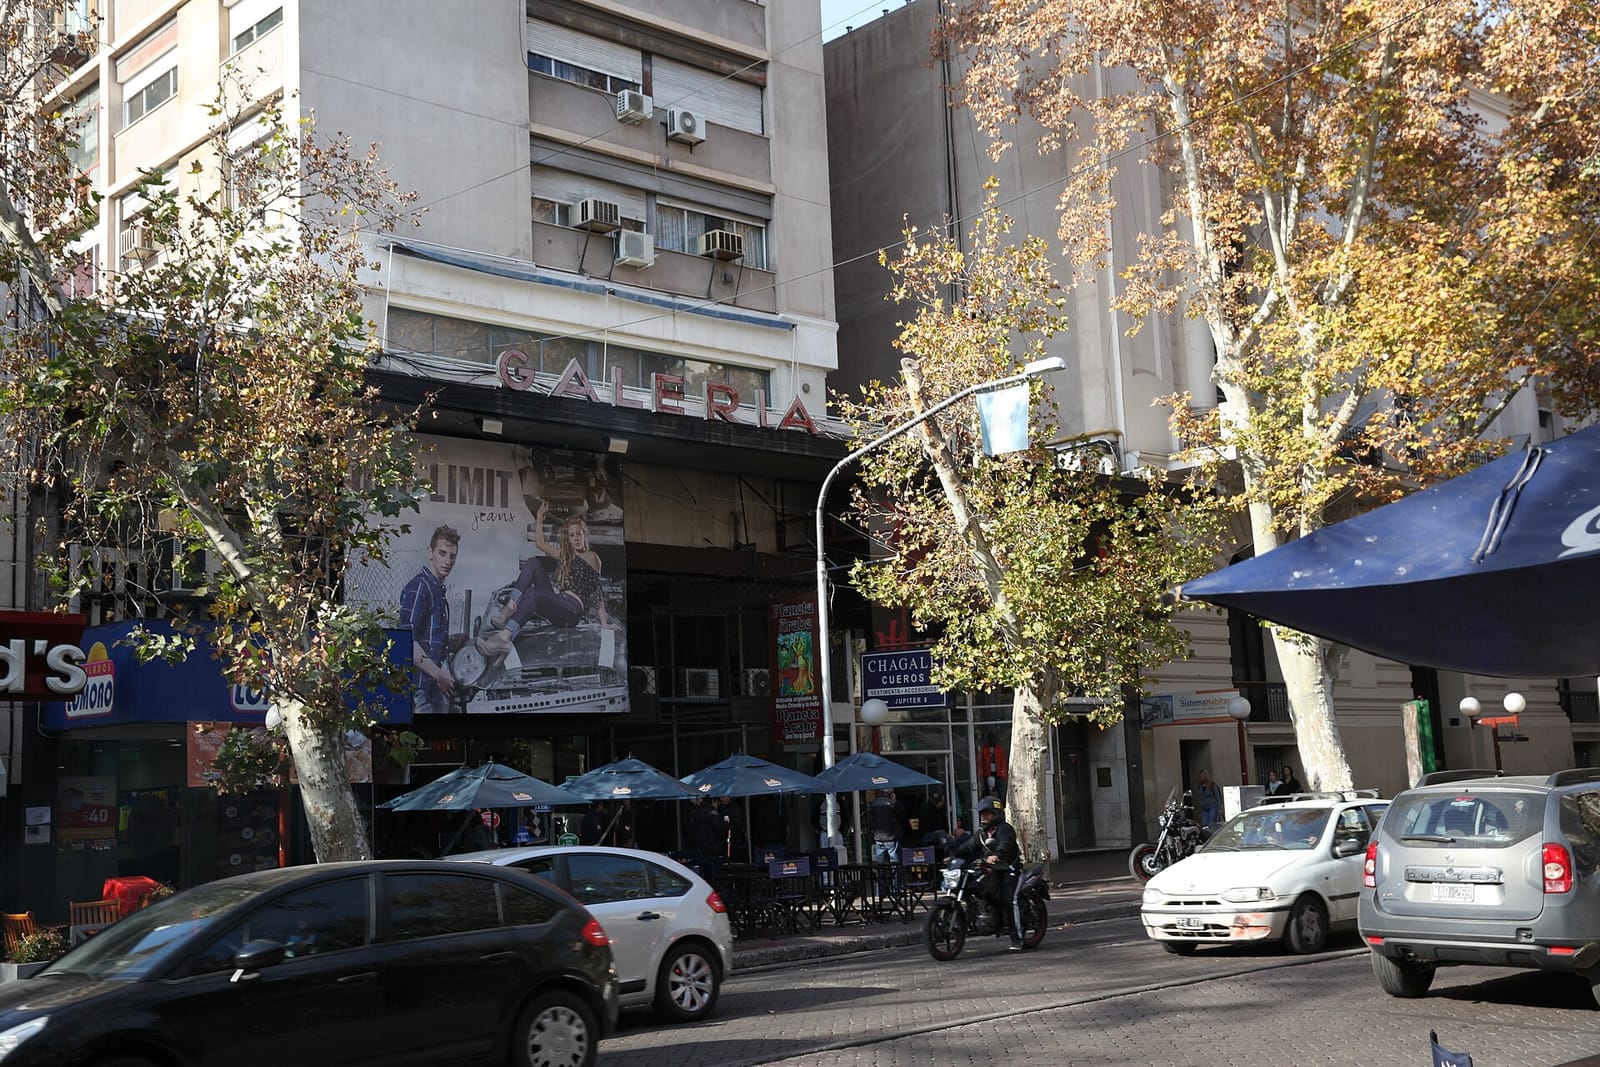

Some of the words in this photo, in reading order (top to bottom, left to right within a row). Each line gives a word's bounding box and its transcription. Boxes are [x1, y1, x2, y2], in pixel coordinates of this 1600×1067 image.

[496, 350, 818, 434] GALERIA
[471, 511, 517, 532] jeans
[881, 673, 925, 685] CUEROS
[895, 697, 921, 705] JUPITER
[776, 709, 819, 722] Planeta
[1407, 872, 1498, 881] DUSTER
[1454, 887, 1472, 898] 269
